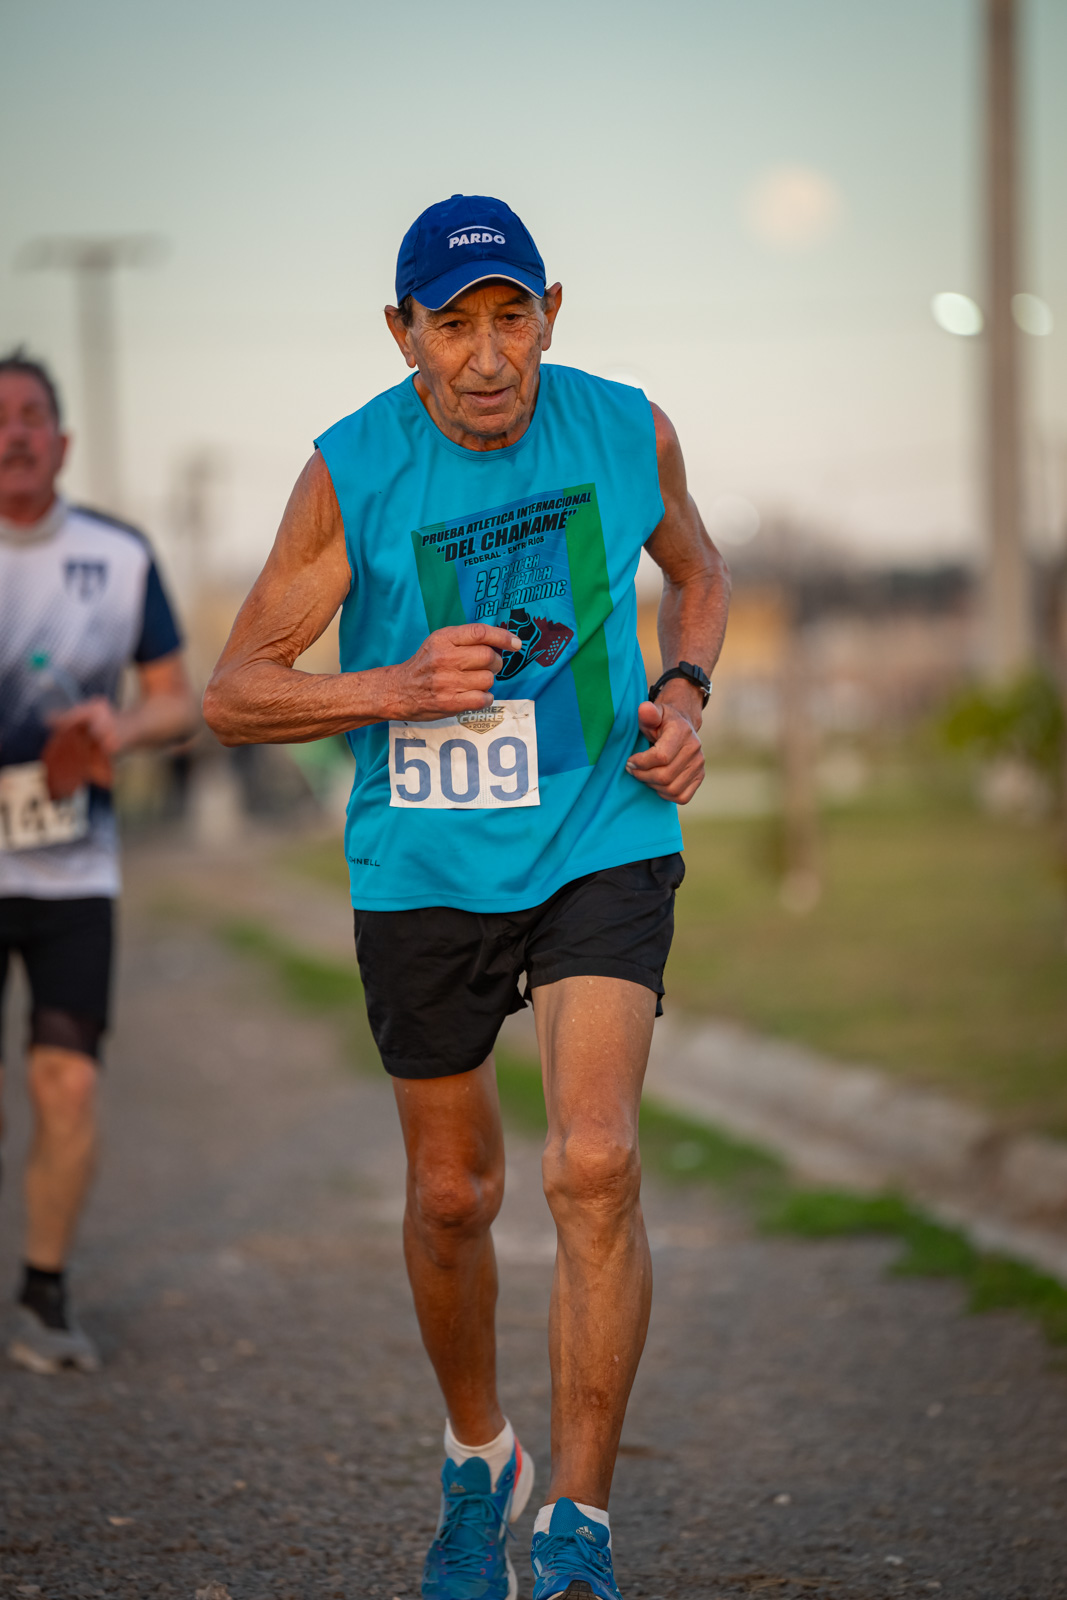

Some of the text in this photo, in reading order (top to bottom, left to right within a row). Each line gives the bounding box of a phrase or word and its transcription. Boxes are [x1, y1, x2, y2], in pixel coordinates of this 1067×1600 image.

[449, 233, 506, 249] PARDO
[422, 492, 591, 546] PRUEBA ATLETICA INTERNACIONAL
[464, 551, 501, 567] FEDERAL
[507, 541, 527, 555] ENTR
[475, 566, 501, 603] 32
[459, 713, 504, 724] CORRE
[394, 736, 529, 803] 509
